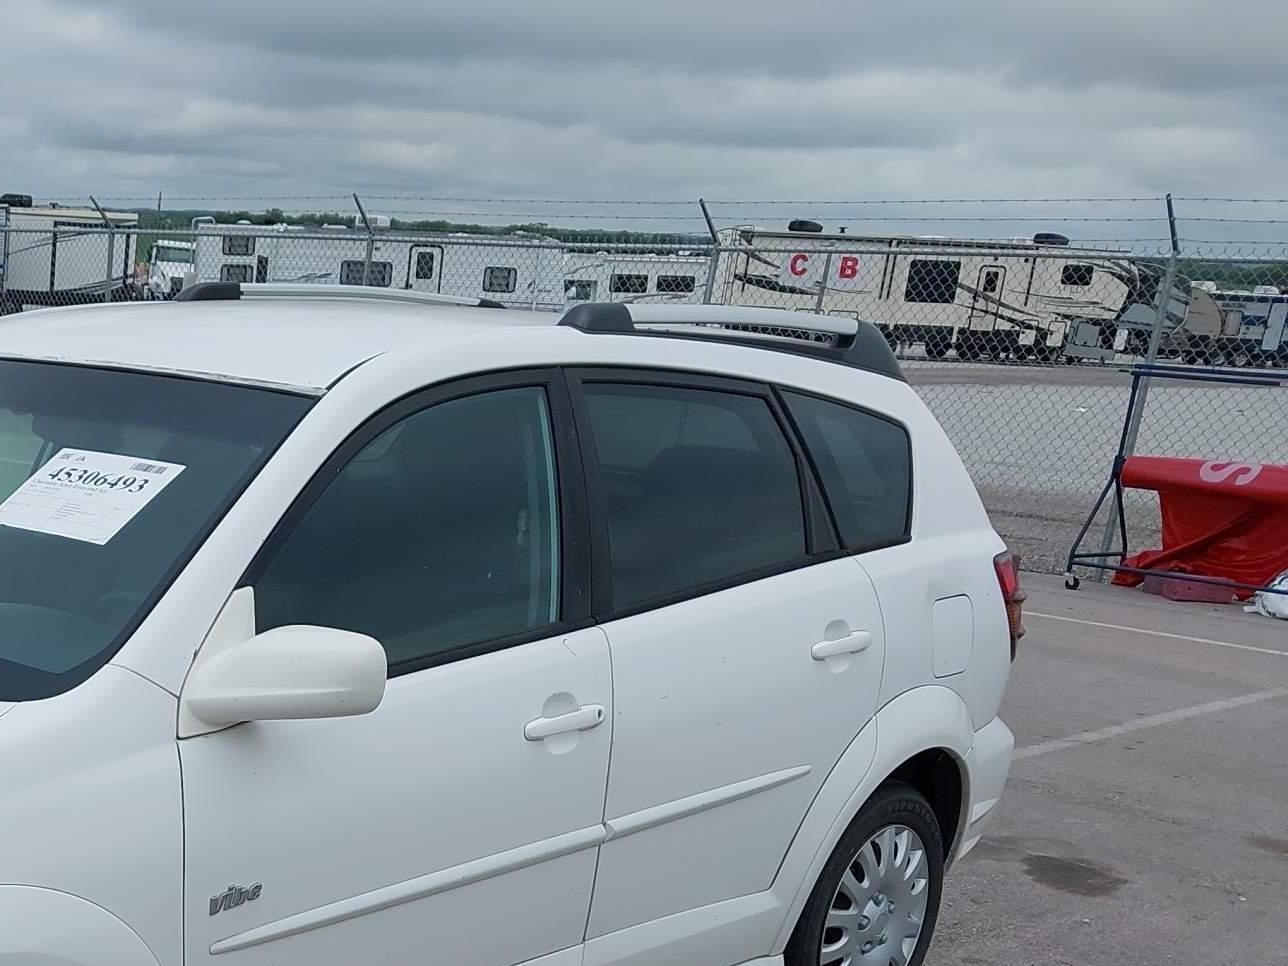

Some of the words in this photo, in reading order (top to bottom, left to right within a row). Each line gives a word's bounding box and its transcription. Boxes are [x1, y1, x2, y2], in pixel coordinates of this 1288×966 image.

[790, 254, 809, 276] C
[839, 256, 859, 279] B
[47, 466, 150, 493] 45306493
[209, 882, 263, 917] vibe
